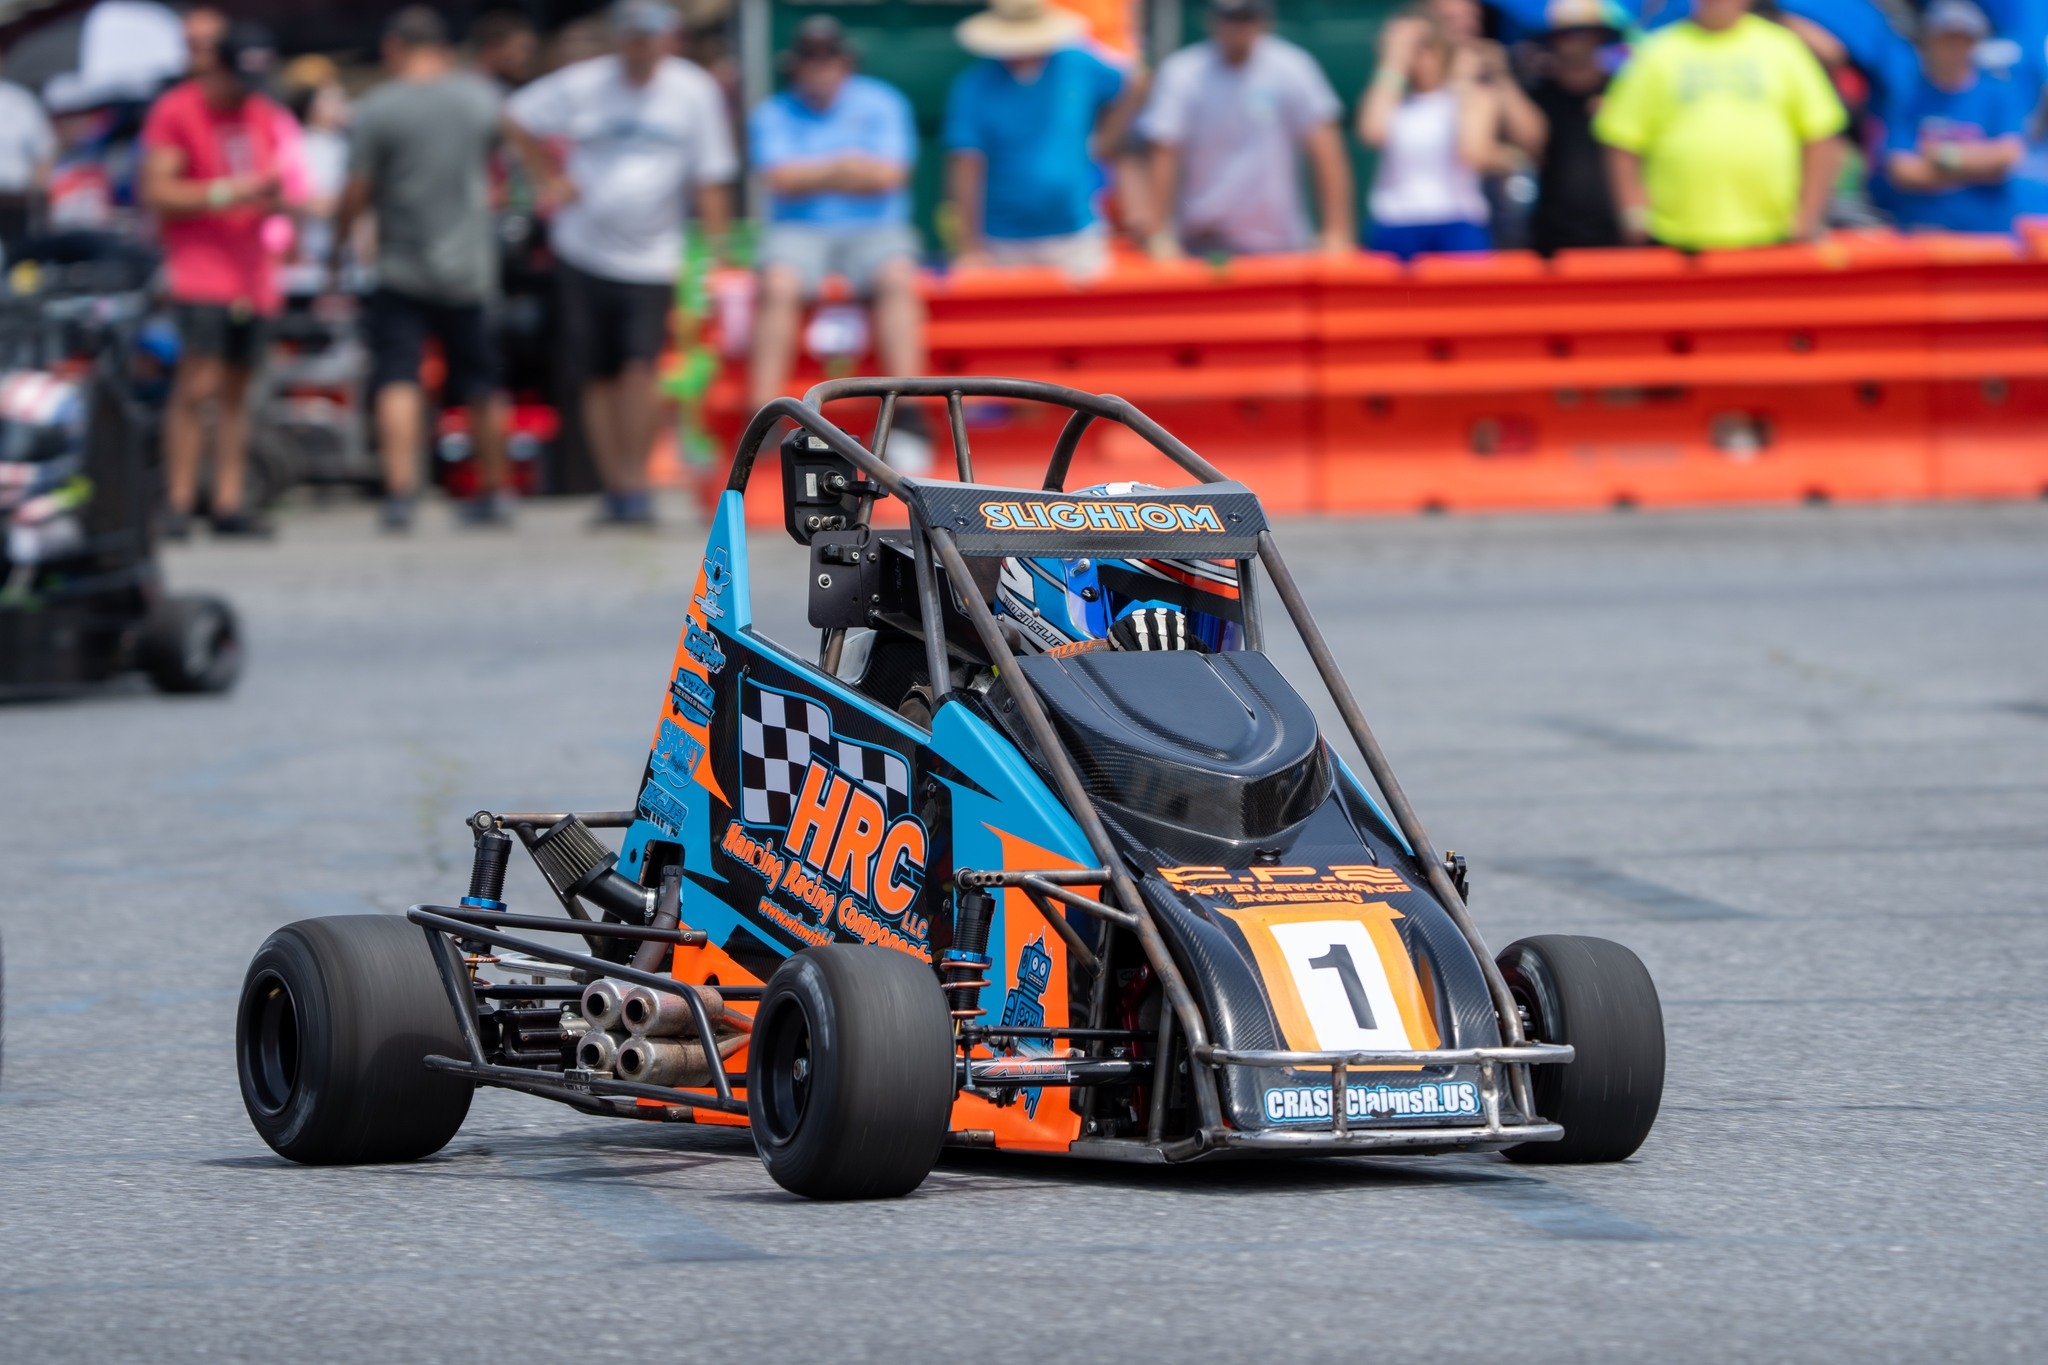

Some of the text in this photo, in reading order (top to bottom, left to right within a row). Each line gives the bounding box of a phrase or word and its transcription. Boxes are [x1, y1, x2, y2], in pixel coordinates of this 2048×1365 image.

[979, 501, 1225, 532] SLIGHTOM
[680, 673, 711, 699] Swift
[785, 760, 925, 916] HRC
[781, 861, 835, 925] Racing
[1171, 883, 1412, 895] FOSTER PERFORMANCE
[1234, 893, 1364, 904] ENGINEERING
[901, 911, 928, 940] LLC
[1308, 943, 1378, 1030] 1
